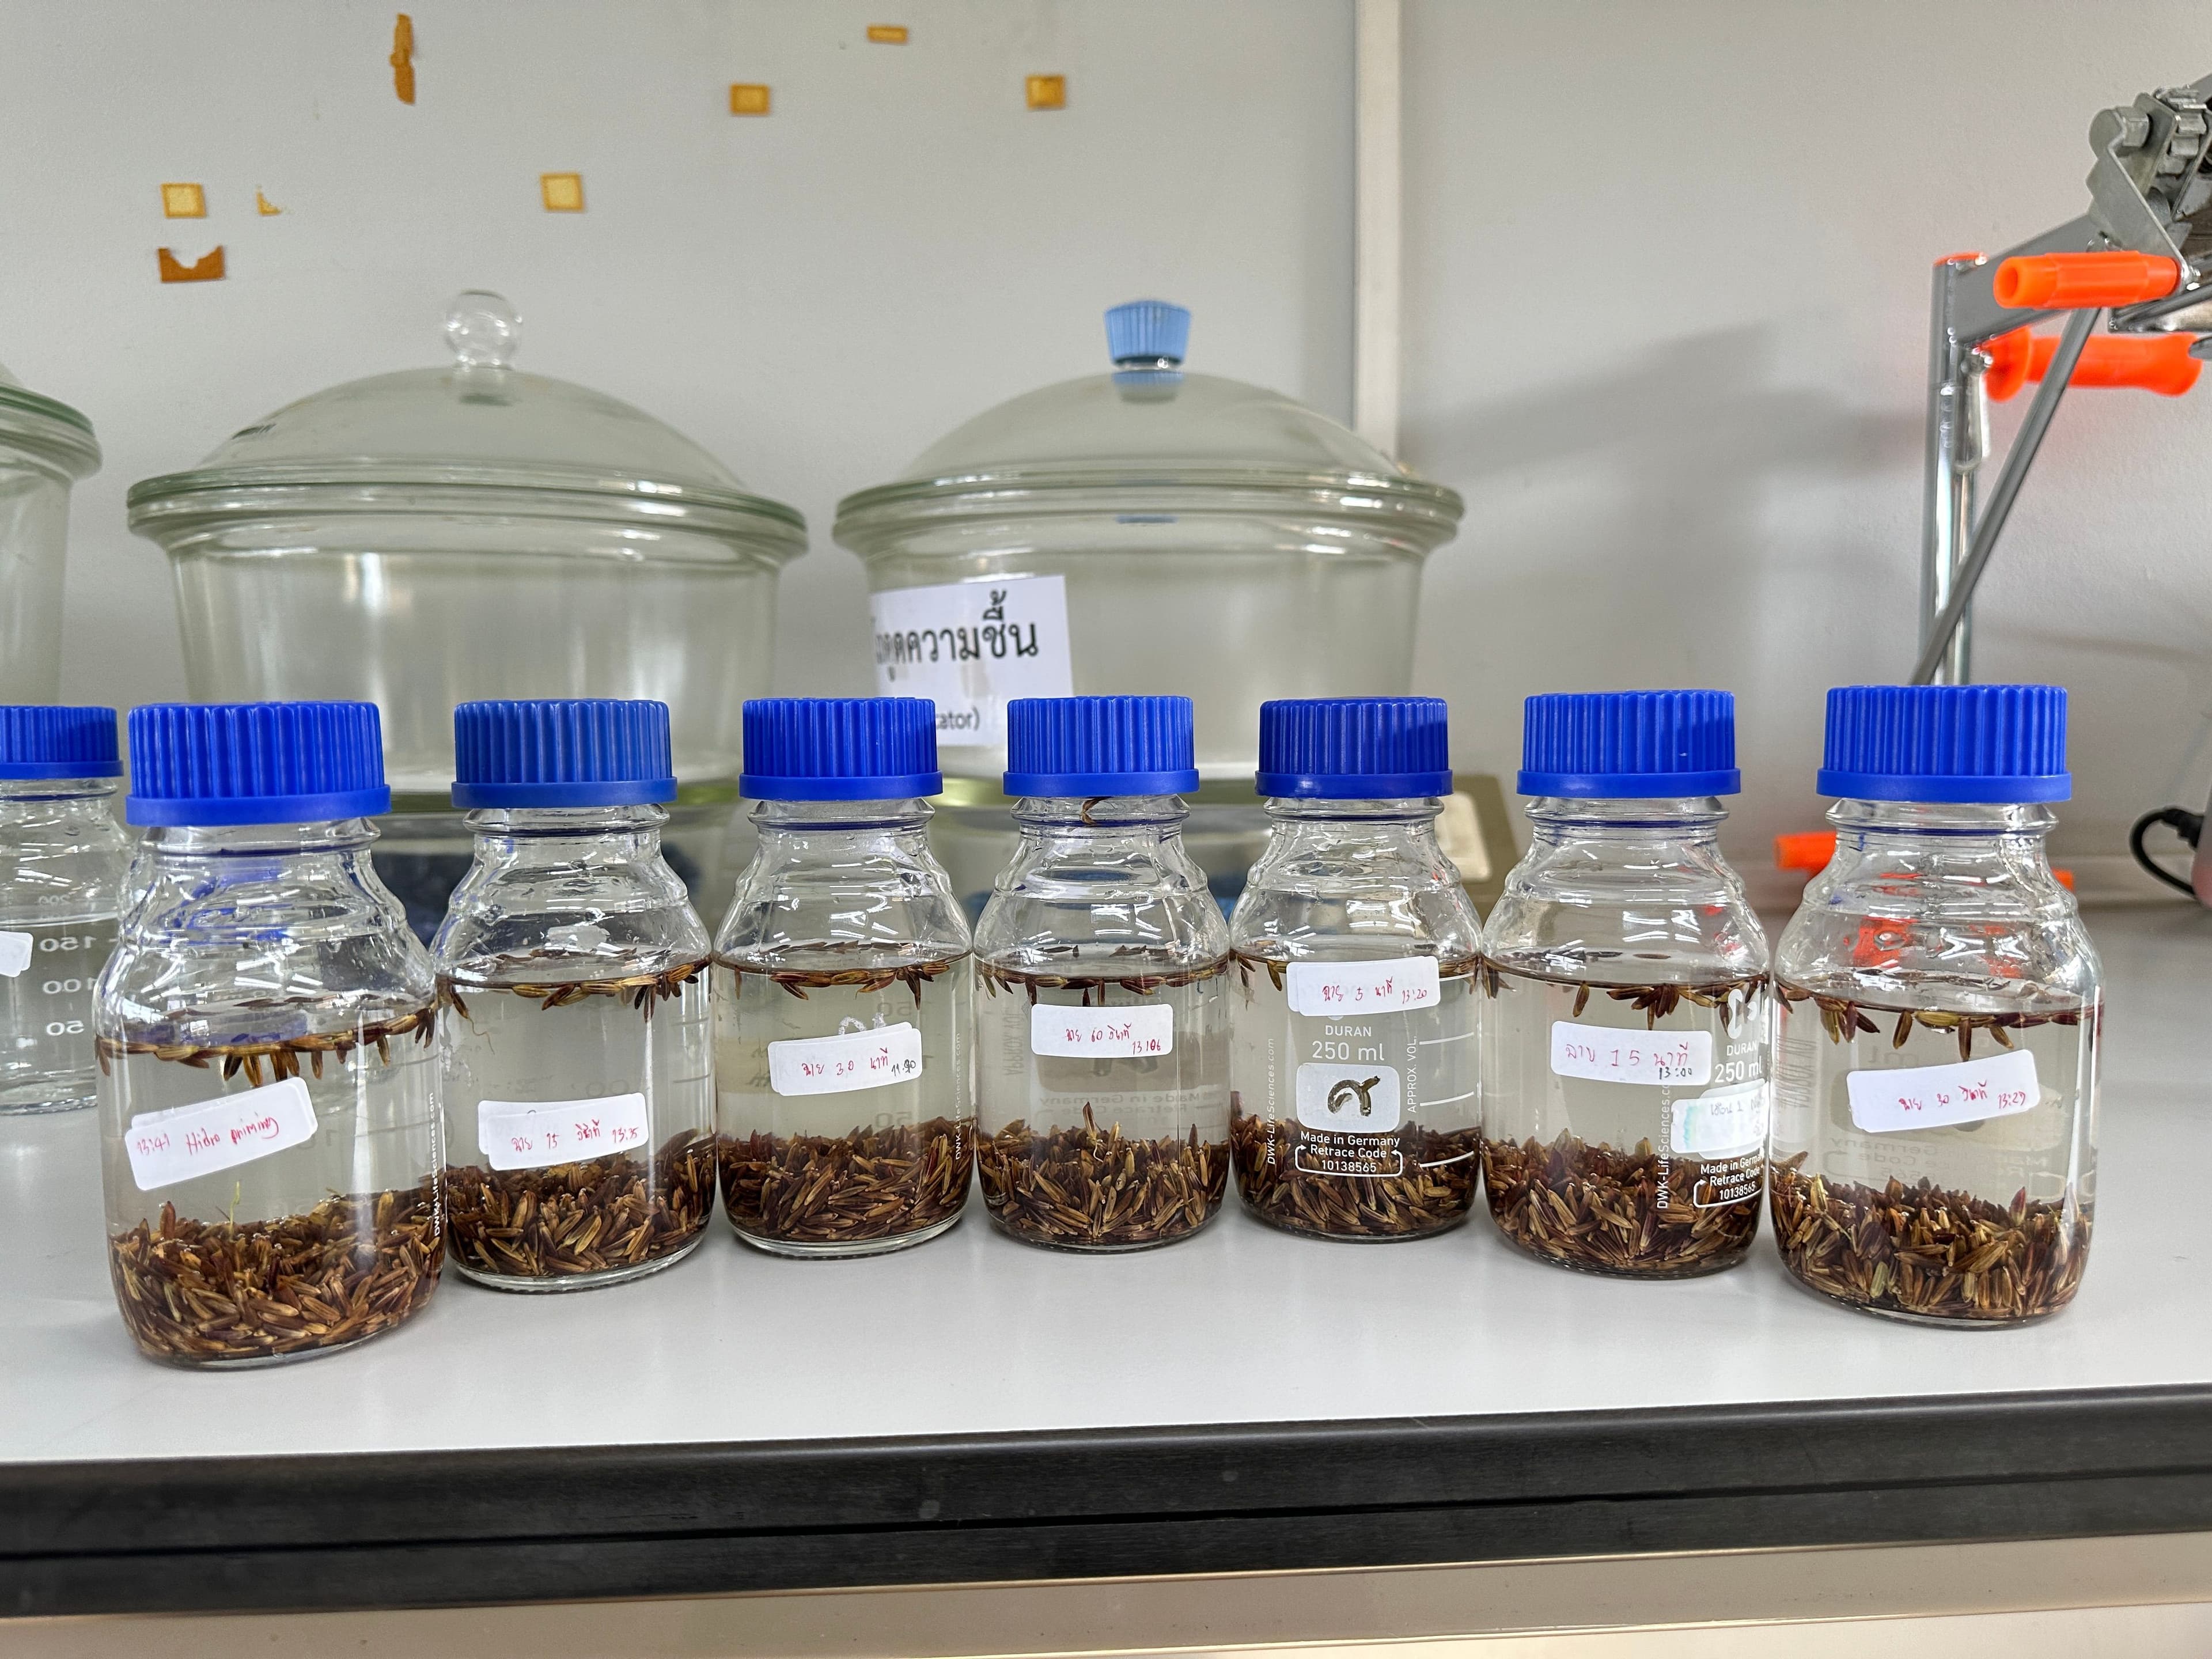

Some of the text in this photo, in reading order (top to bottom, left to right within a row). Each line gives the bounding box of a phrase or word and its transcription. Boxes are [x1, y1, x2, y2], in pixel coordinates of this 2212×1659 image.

[1325, 1025, 1372, 1037] DURAN
[1312, 1040, 1384, 1060] 250 ml
[1727, 1041, 1757, 1056] DURAN
[1714, 1055, 1762, 1083] 250 ml
[1407, 1064, 1416, 1113] APPROX.
[1267, 1038, 1275, 1165] DWK-LifeSciences.com
[1300, 1131, 1400, 1147] Made in Germany
[1310, 1144, 1387, 1158] Retrace Code
[1322, 1160, 1377, 1173] 10138565
[1700, 1162, 1728, 1175] Made
[1730, 1160, 1738, 1171] in
[1710, 1165, 1760, 1187] Retrace Code
[1719, 1181, 1756, 1200] 10138565
